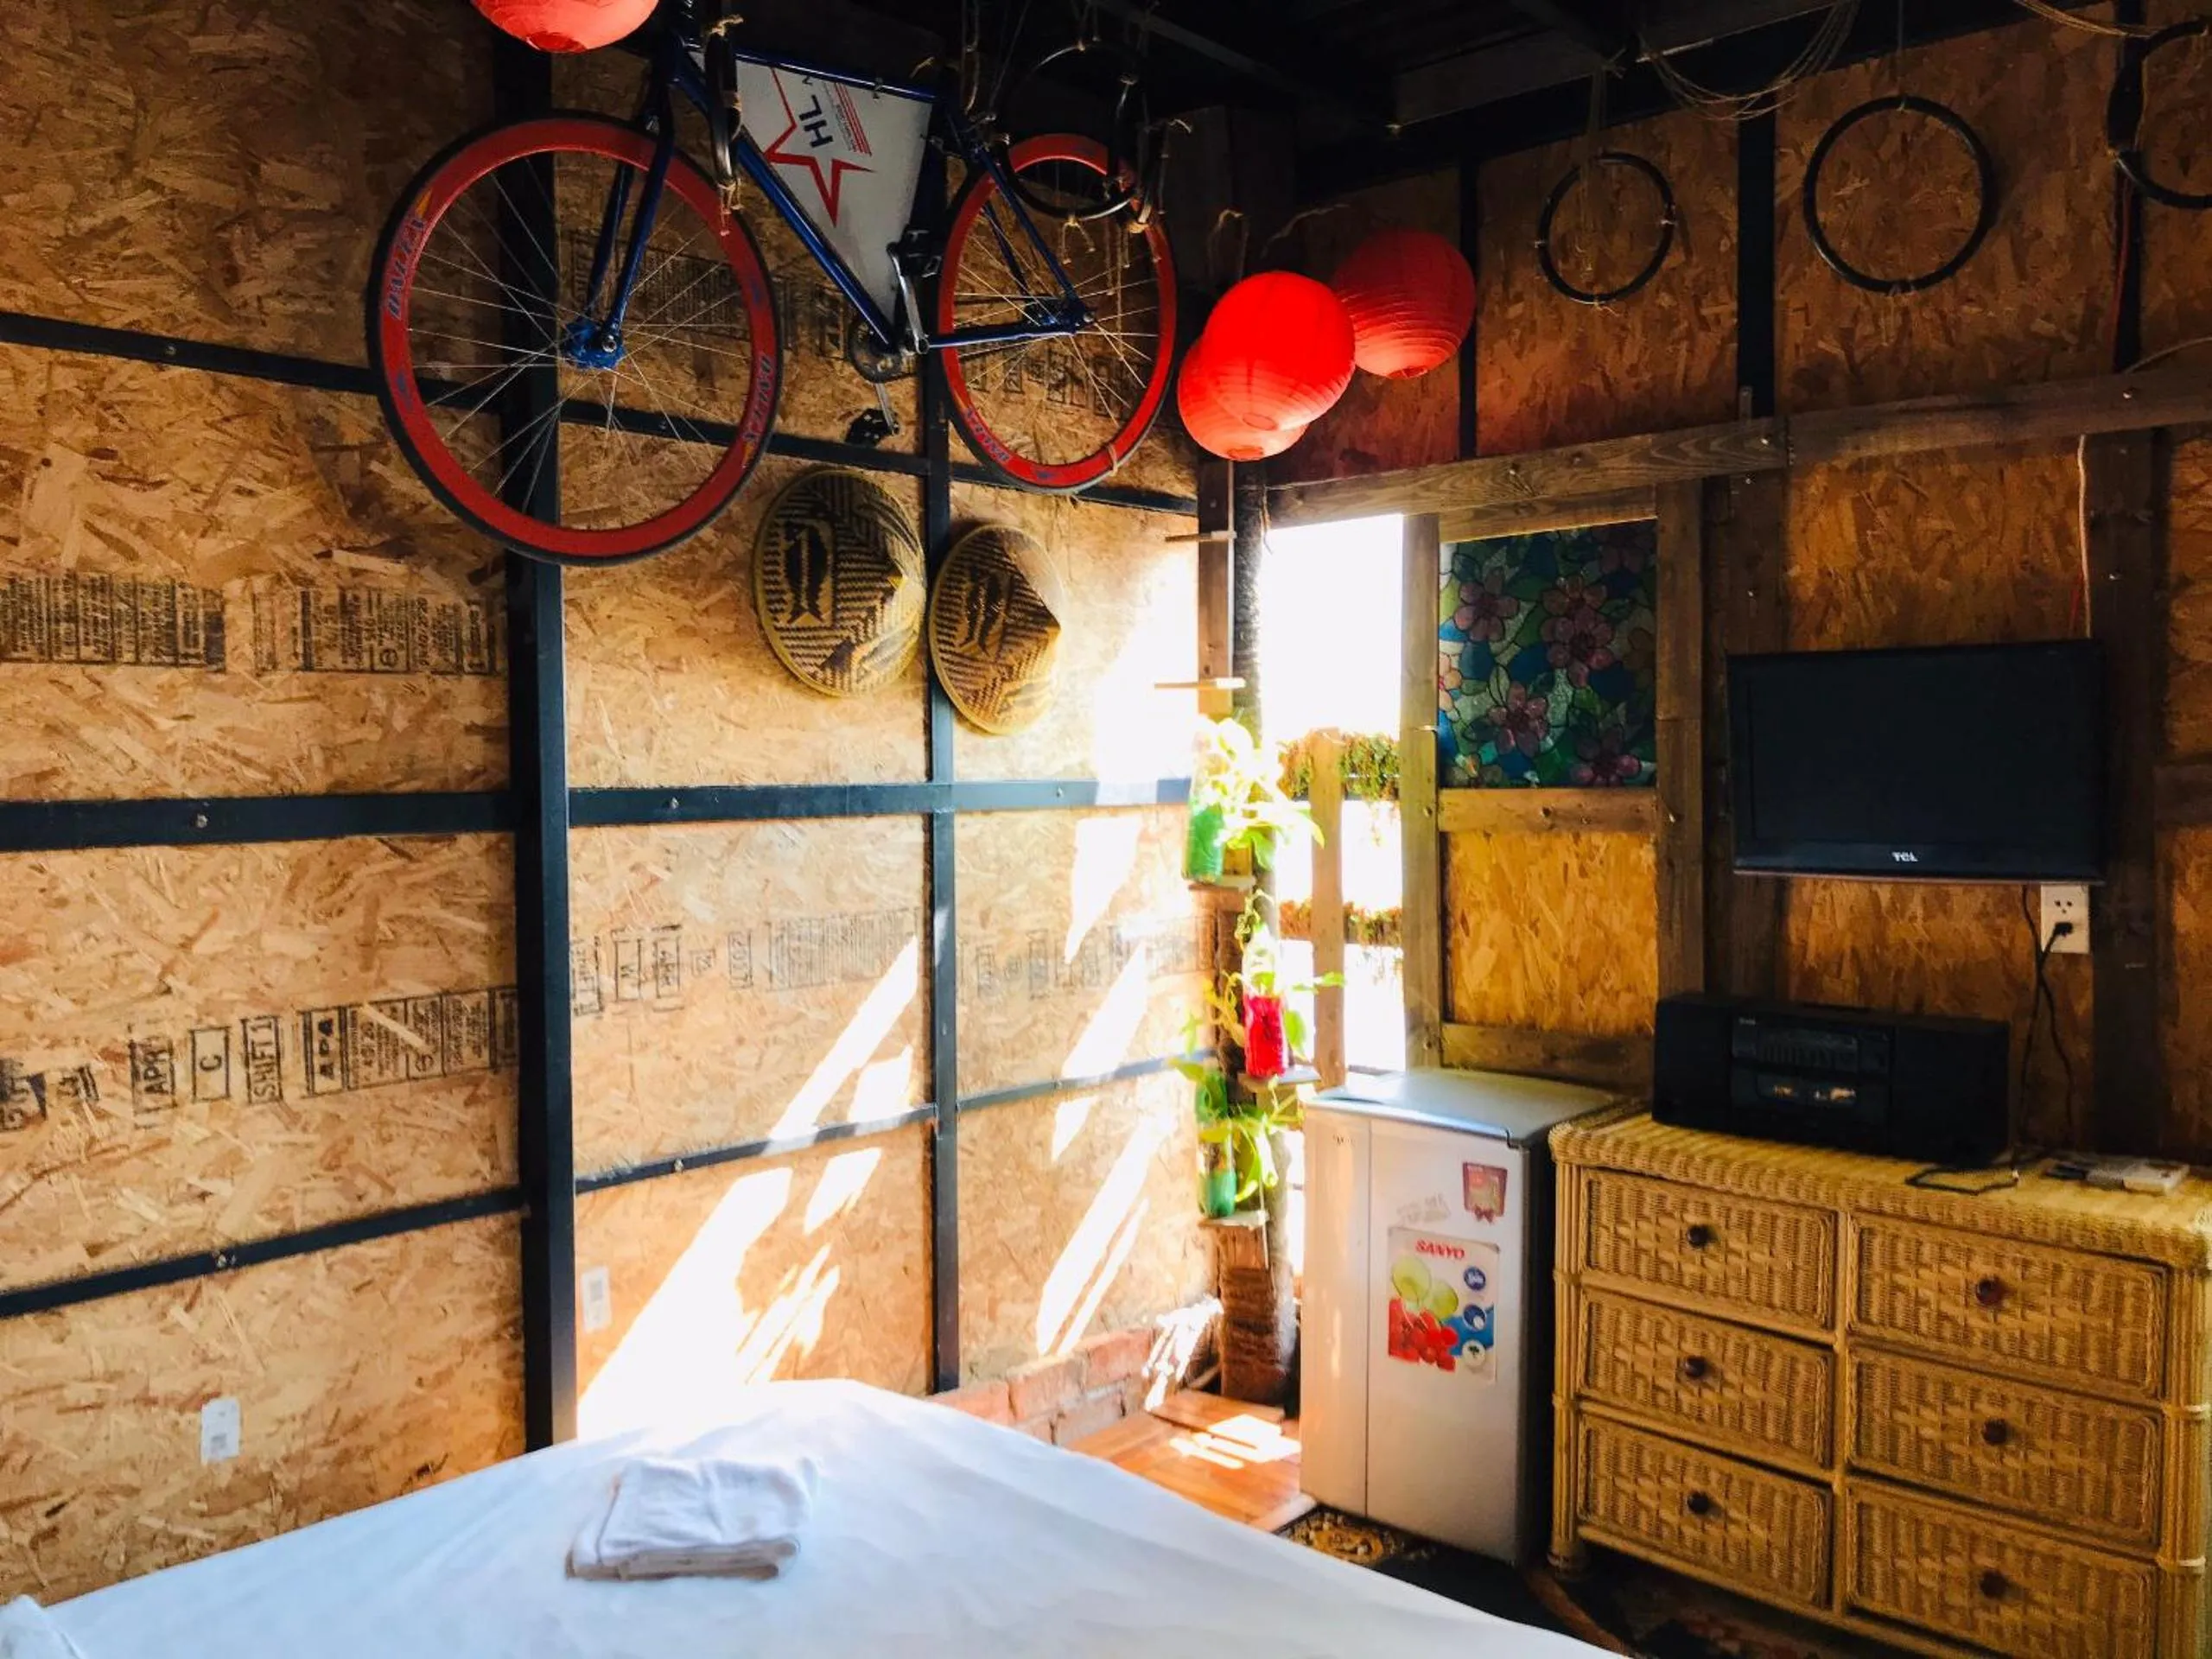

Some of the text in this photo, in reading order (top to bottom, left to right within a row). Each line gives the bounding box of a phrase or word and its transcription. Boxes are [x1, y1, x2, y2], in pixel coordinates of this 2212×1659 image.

[1891, 851, 1918, 862] TCL
[199, 1053, 223, 1072] C
[250, 1039, 276, 1097] SHIFT
[1416, 1240, 1465, 1260] SANYO
